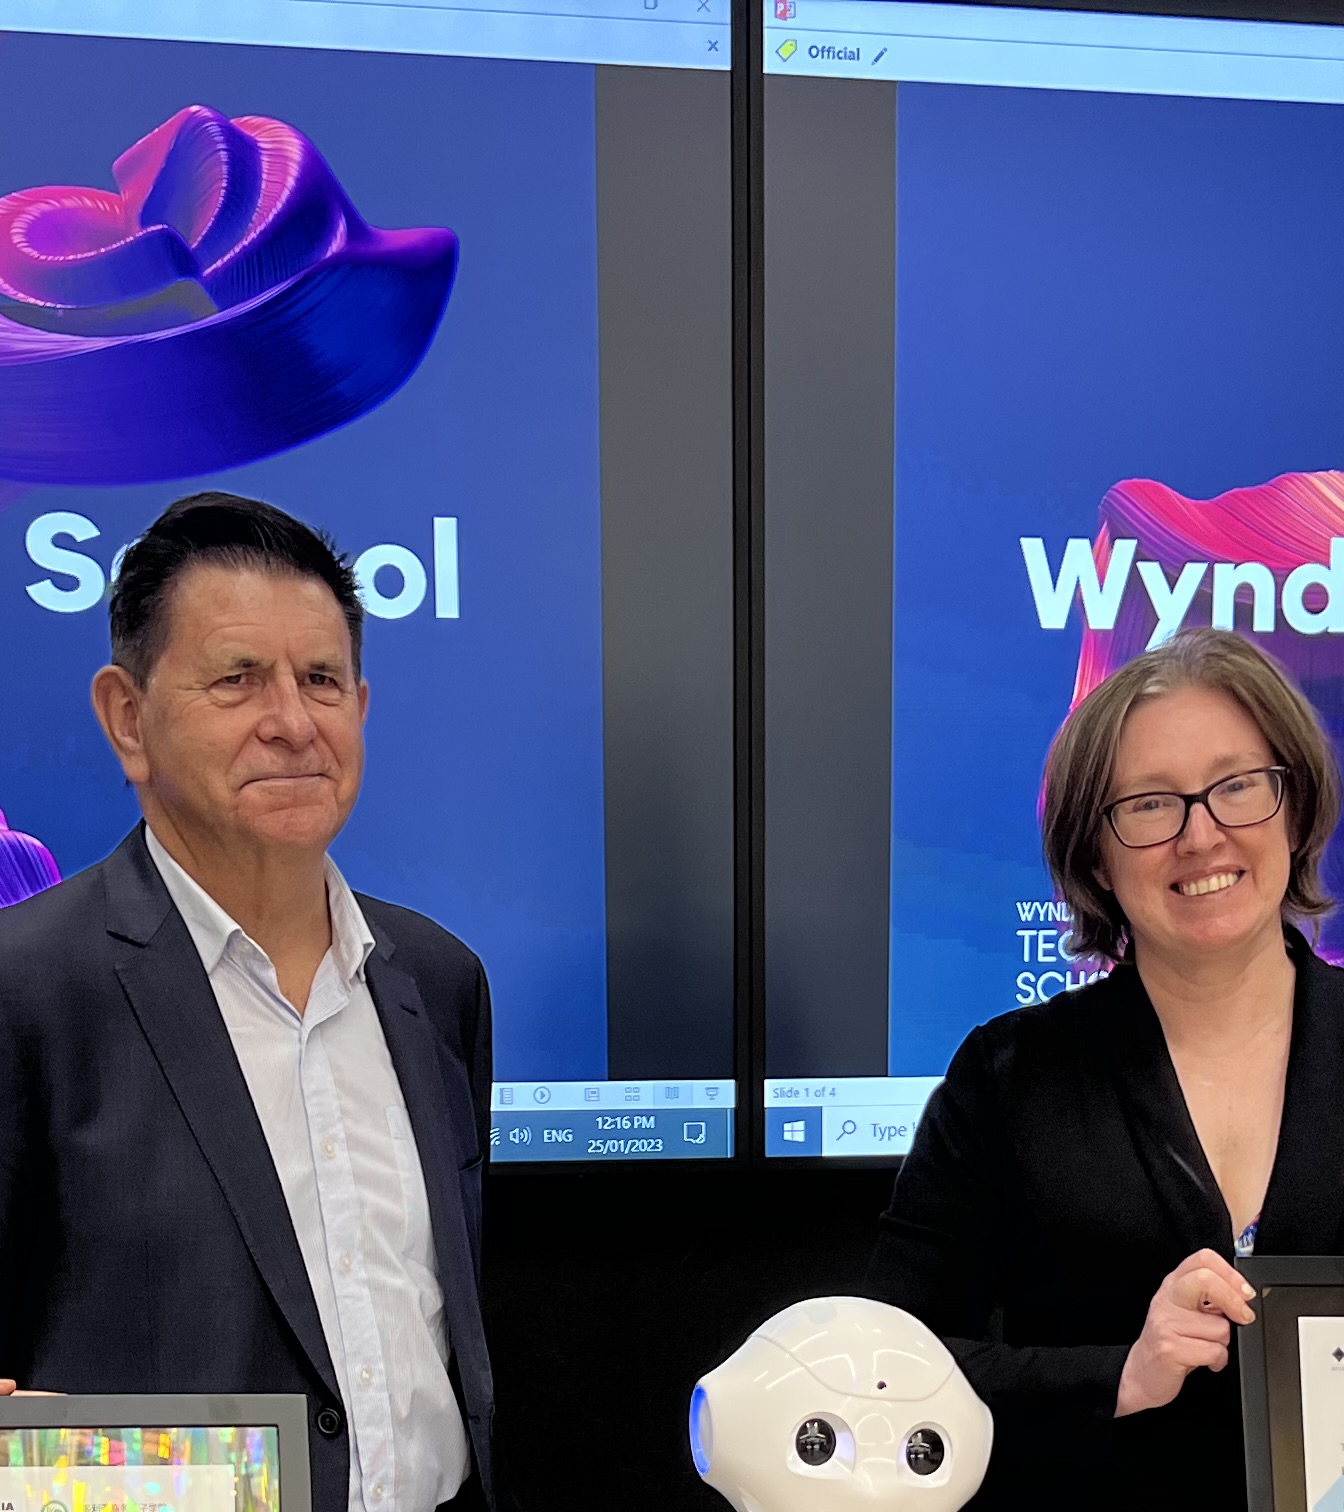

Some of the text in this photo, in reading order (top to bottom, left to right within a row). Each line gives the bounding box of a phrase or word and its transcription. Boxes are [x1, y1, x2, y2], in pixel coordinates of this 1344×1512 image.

[808, 45, 860, 61] Official
[25, 510, 460, 619] Sol
[1016, 930, 1084, 963] TEC
[772, 1087, 800, 1099] Slide
[814, 1086, 826, 1098] of
[829, 1087, 837, 1098] 4
[596, 1115, 656, 1130] 12:16 PM
[543, 1129, 574, 1143] ENG
[870, 1123, 906, 1142] Type
[587, 1138, 664, 1154] 25/01/2023
